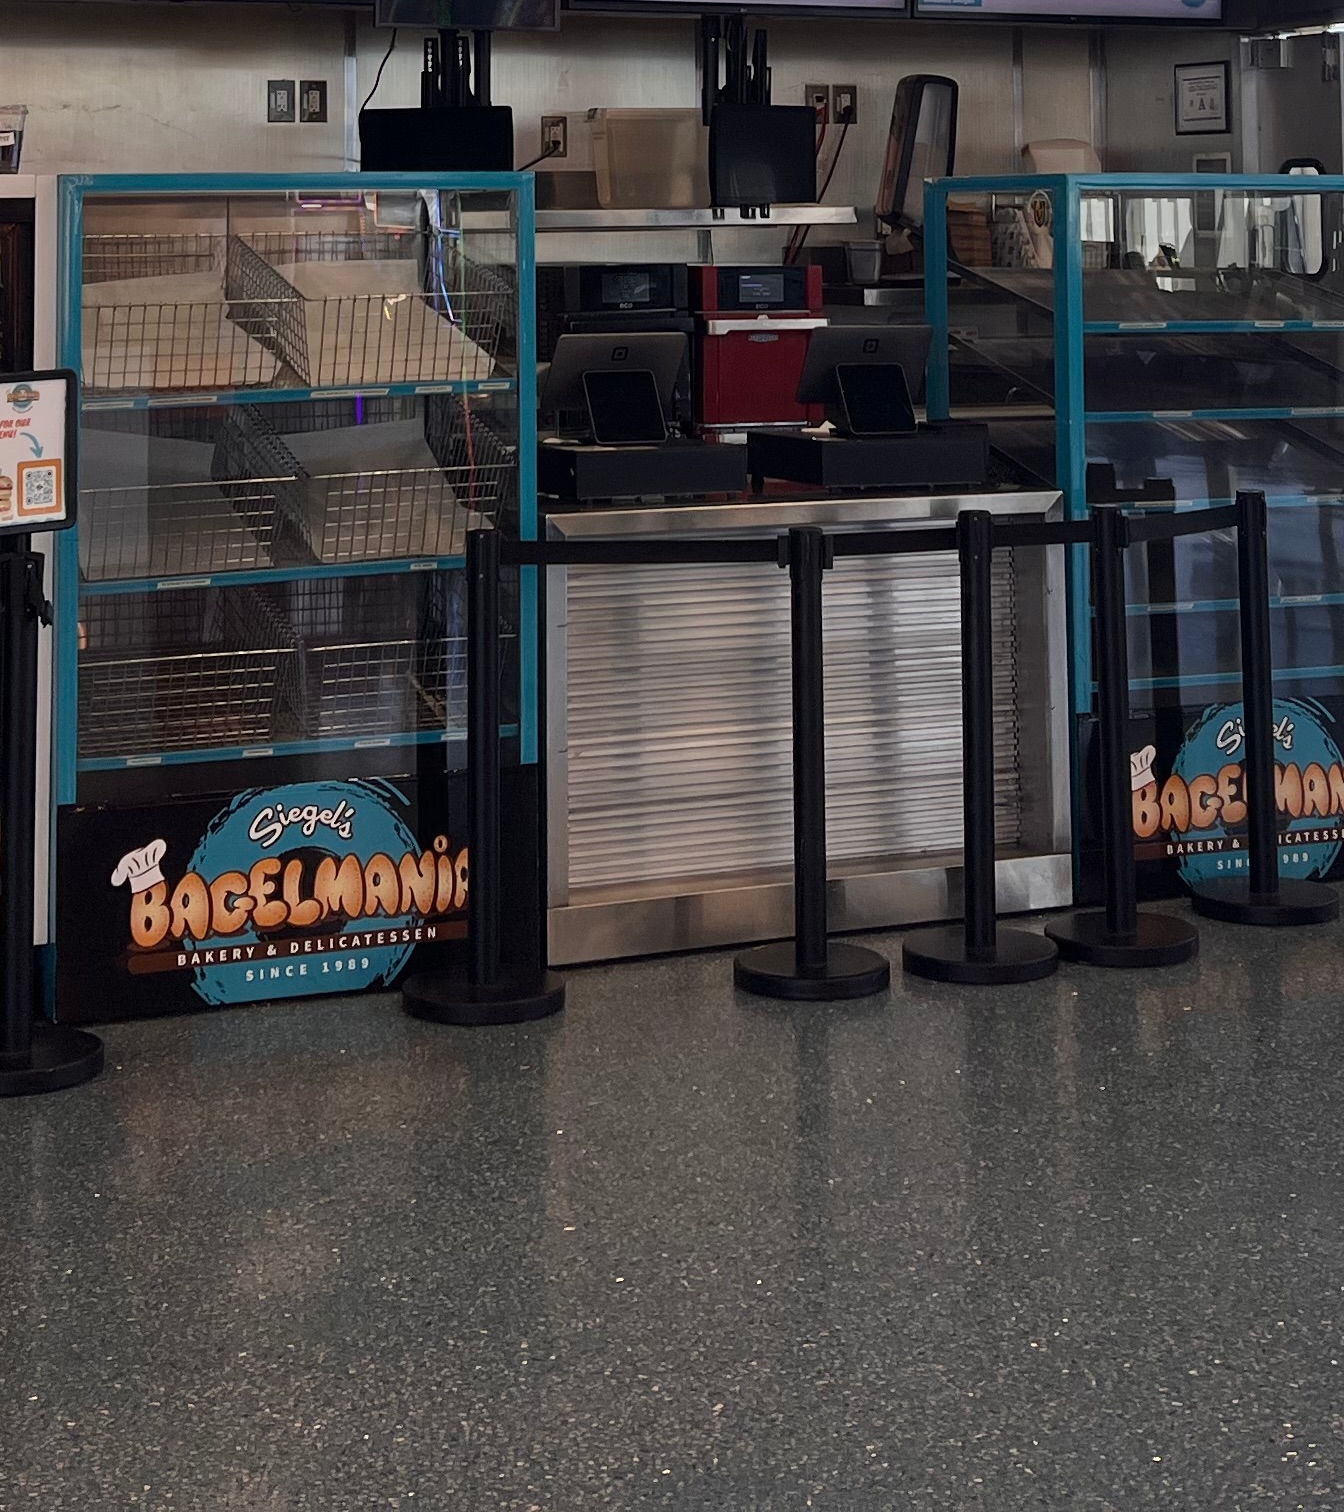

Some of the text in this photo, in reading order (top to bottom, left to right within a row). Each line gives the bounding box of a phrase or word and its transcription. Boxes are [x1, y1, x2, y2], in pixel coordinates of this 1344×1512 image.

[0, 420, 14, 428] FOR
[15, 418, 31, 427] OUR
[248, 800, 356, 849] Siegel's
[1166, 839, 1224, 856] BAKERY
[1232, 838, 1240, 848] &
[1283, 853, 1309, 864] 989
[177, 927, 438, 967] BAKERY & DELICATESSEN
[245, 958, 370, 981] SINCE 1989
